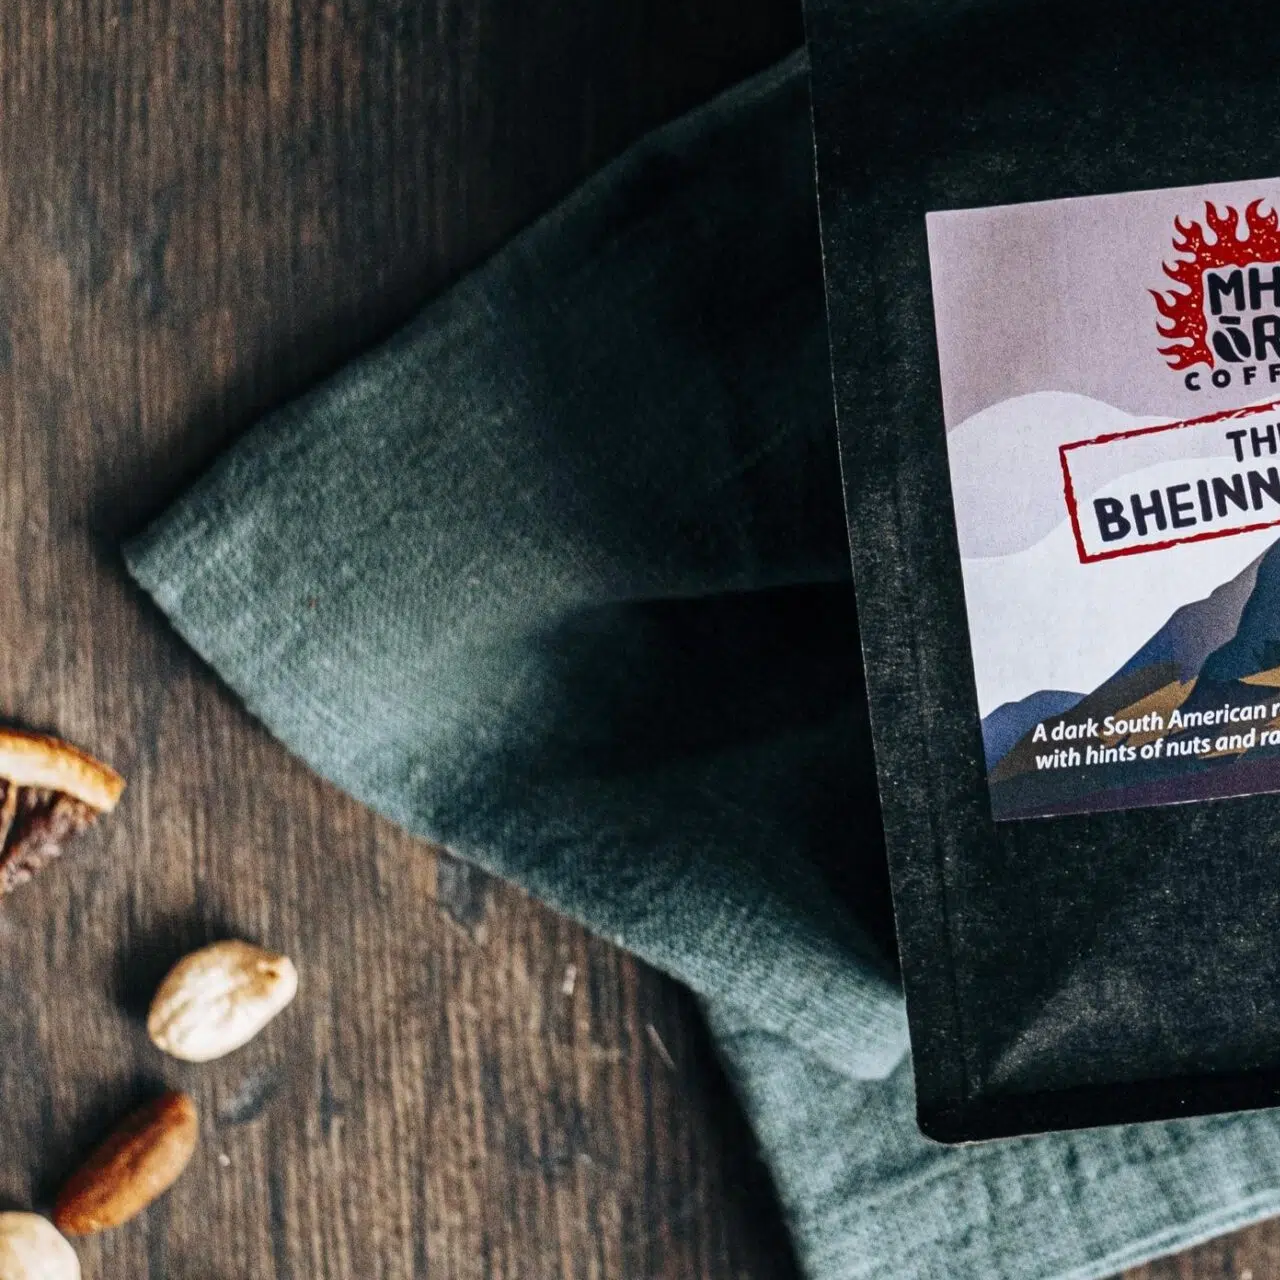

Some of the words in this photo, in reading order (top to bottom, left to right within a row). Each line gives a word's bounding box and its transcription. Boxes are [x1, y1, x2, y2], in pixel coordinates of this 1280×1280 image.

[1031, 722, 1047, 743] A
[1051, 717, 1098, 741] dark
[1103, 714, 1165, 737] South
[1167, 702, 1267, 730] American
[1035, 747, 1081, 770] with
[1085, 743, 1137, 765] hints
[1140, 739, 1163, 759] of
[1166, 736, 1210, 756] nuts
[1214, 726, 1252, 751] and
